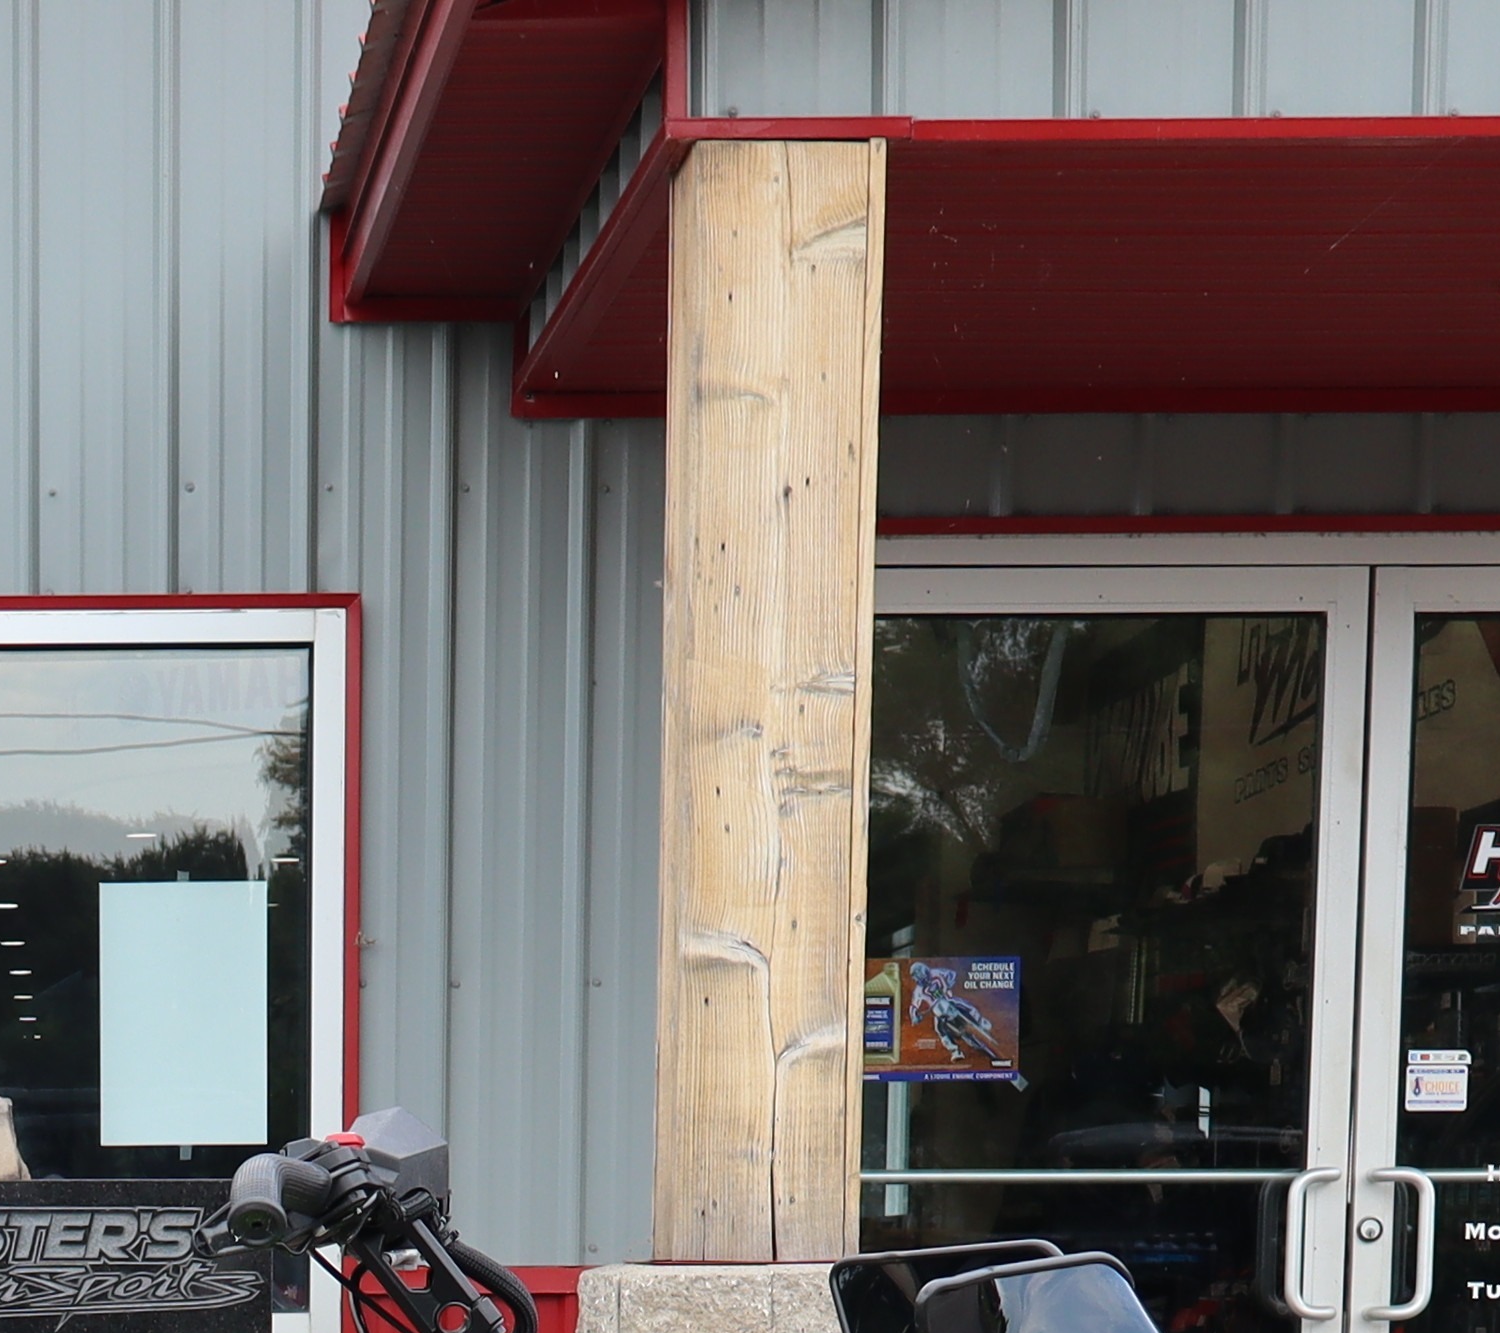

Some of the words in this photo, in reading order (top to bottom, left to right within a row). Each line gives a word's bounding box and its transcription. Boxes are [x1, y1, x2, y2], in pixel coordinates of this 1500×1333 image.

[971, 962, 1015, 972] SCHEDULE
[968, 971, 991, 980] YOUR
[992, 972, 1015, 980] NEXT
[963, 980, 978, 989] OIL
[979, 980, 1015, 990] CHANGE
